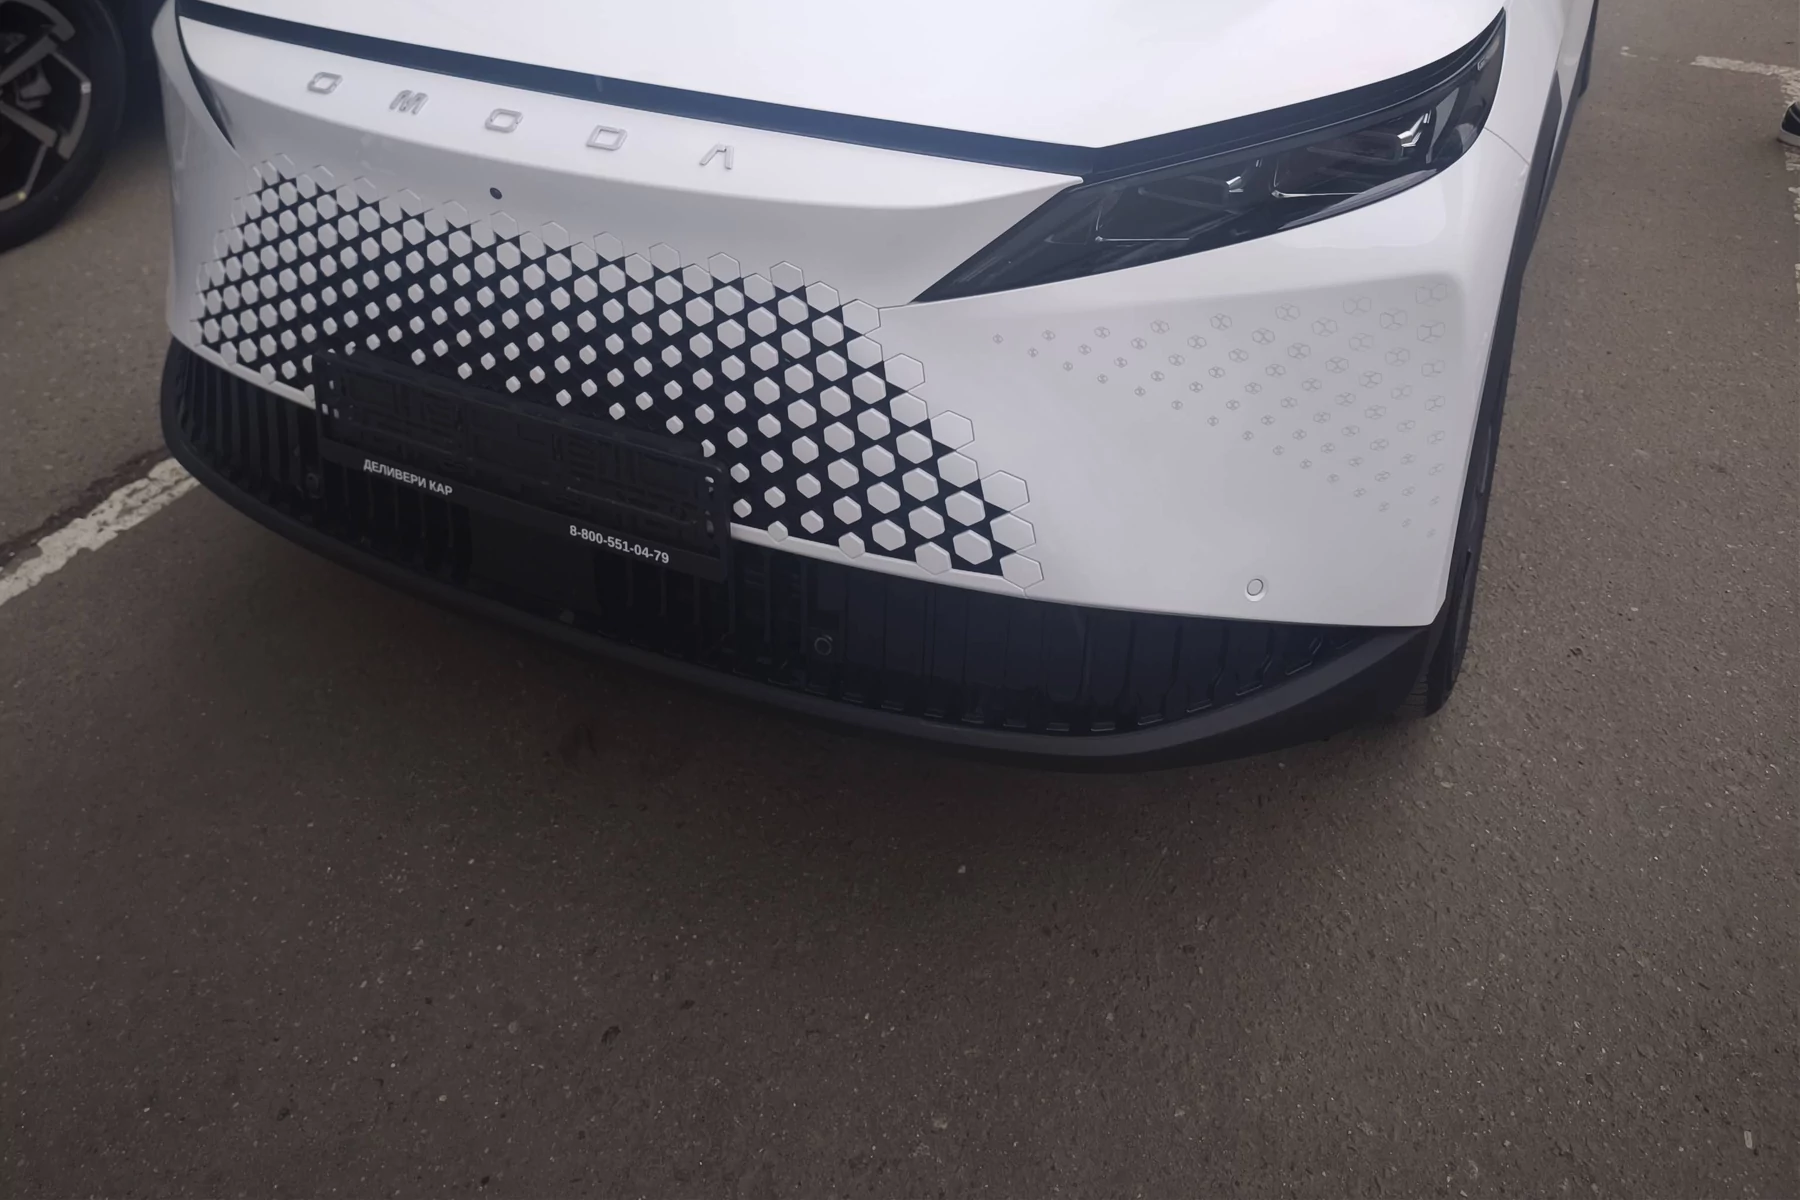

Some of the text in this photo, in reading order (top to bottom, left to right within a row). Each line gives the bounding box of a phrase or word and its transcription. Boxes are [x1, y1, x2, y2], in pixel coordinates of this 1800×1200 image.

[363, 459, 453, 496] ДЕЛИВЕРИ КАР
[569, 524, 670, 564] 8-800-551-04-79
